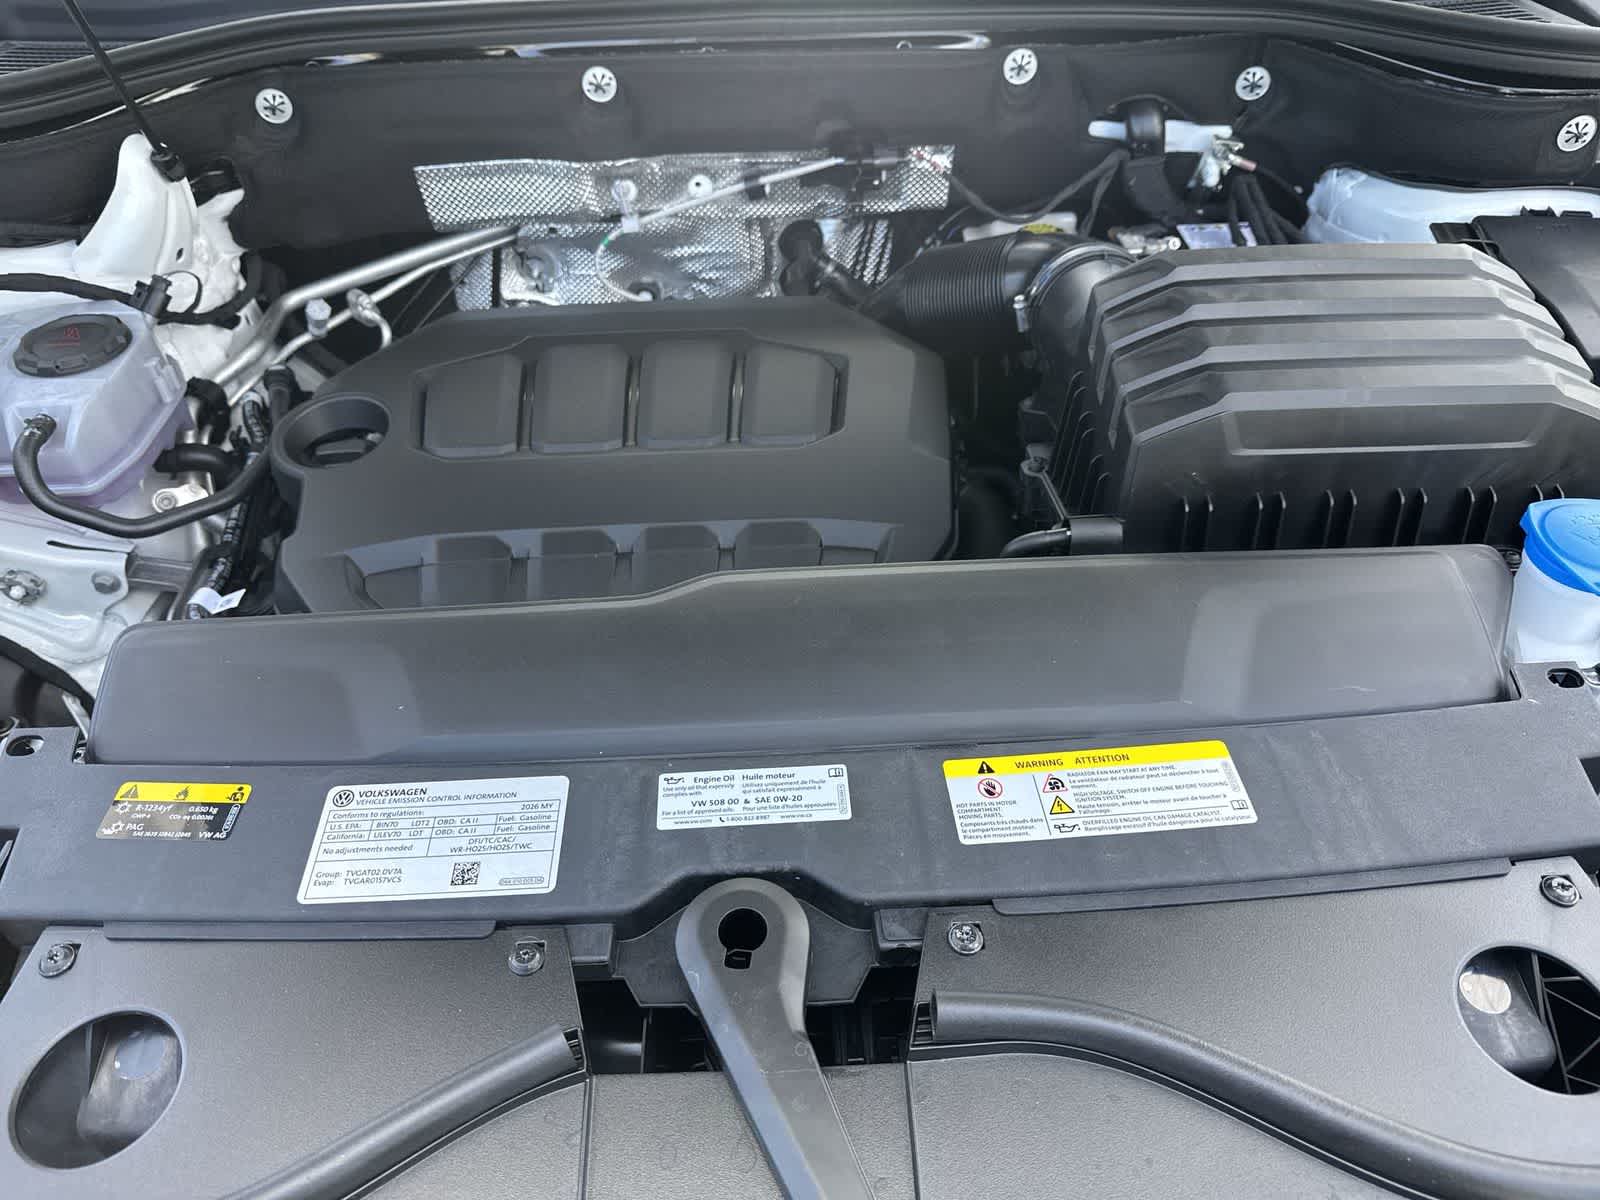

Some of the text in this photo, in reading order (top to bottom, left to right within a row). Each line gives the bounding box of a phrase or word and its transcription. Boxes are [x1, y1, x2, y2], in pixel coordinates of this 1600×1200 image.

[1014, 753, 1130, 769] WARNING ATTENTION
[693, 774, 735, 784] Engine Oil
[1198, 780, 1229, 788] TOUCHING
[359, 788, 428, 798] VOLKSWAGEN
[356, 797, 386, 805] VEHICLE
[388, 796, 425, 804] EMISSION
[464, 791, 517, 801] INFORMATION
[754, 796, 771, 804] SAE
[773, 794, 803, 803] 0W-20
[135, 804, 174, 814] R-1234yf
[208, 806, 219, 815] kg
[521, 803, 539, 811] 2026
[694, 807, 722, 815] approved
[332, 812, 368, 820] Conforms
[381, 810, 425, 819] regulations:
[125, 823, 144, 831] PAG
[517, 824, 551, 832] Gasoline
[960, 820, 996, 828] Composants
[968, 826, 1012, 834] compartiment
[214, 831, 227, 839] AG
[326, 833, 365, 841] California:
[373, 831, 402, 839] ULEV70
[334, 845, 383, 856] adjustments
[384, 844, 414, 852] needed
[315, 871, 342, 880] Group:
